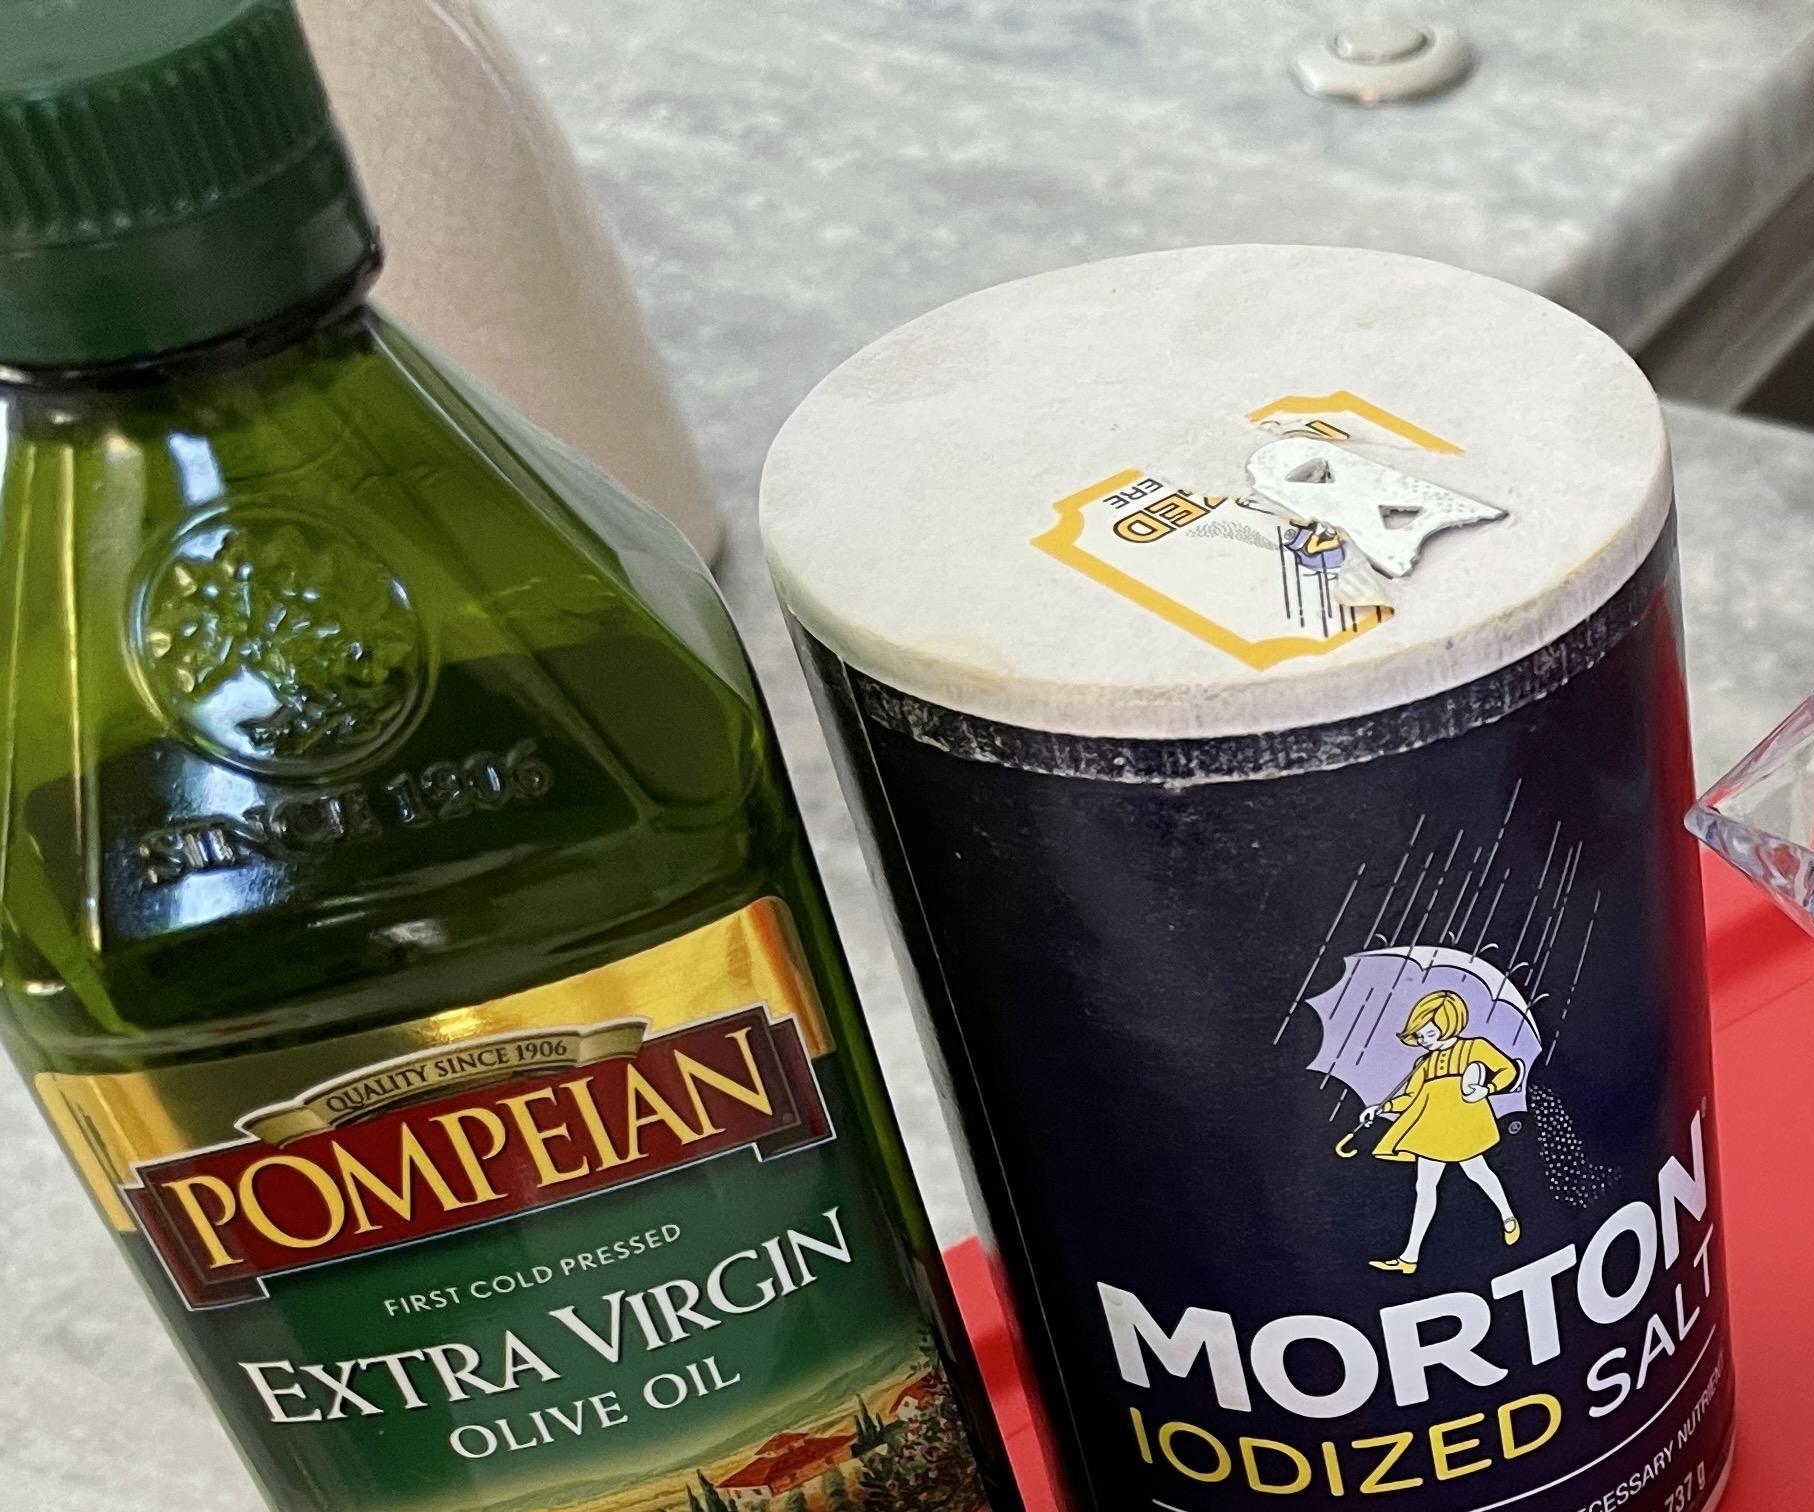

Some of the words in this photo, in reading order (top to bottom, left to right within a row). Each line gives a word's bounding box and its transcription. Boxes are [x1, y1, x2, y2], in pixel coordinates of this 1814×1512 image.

[162, 1026, 777, 1271] POMPEIAN
[325, 1062, 428, 1115] QUALITY
[435, 1046, 510, 1079] SINCE
[516, 1037, 569, 1062] 1906
[238, 1328, 561, 1425] EXTRA
[549, 1206, 856, 1365] VIRGIN
[383, 1286, 461, 1317] FIRST
[475, 1265, 553, 1302] COLD
[559, 1223, 682, 1276] PRESSED
[1097, 1109, 1708, 1418] MORTON
[1129, 1393, 1563, 1497] IODIZED
[1587, 1223, 1715, 1418] SALT
[449, 1391, 628, 1461] OLIVE
[642, 1355, 742, 1409] OIL
